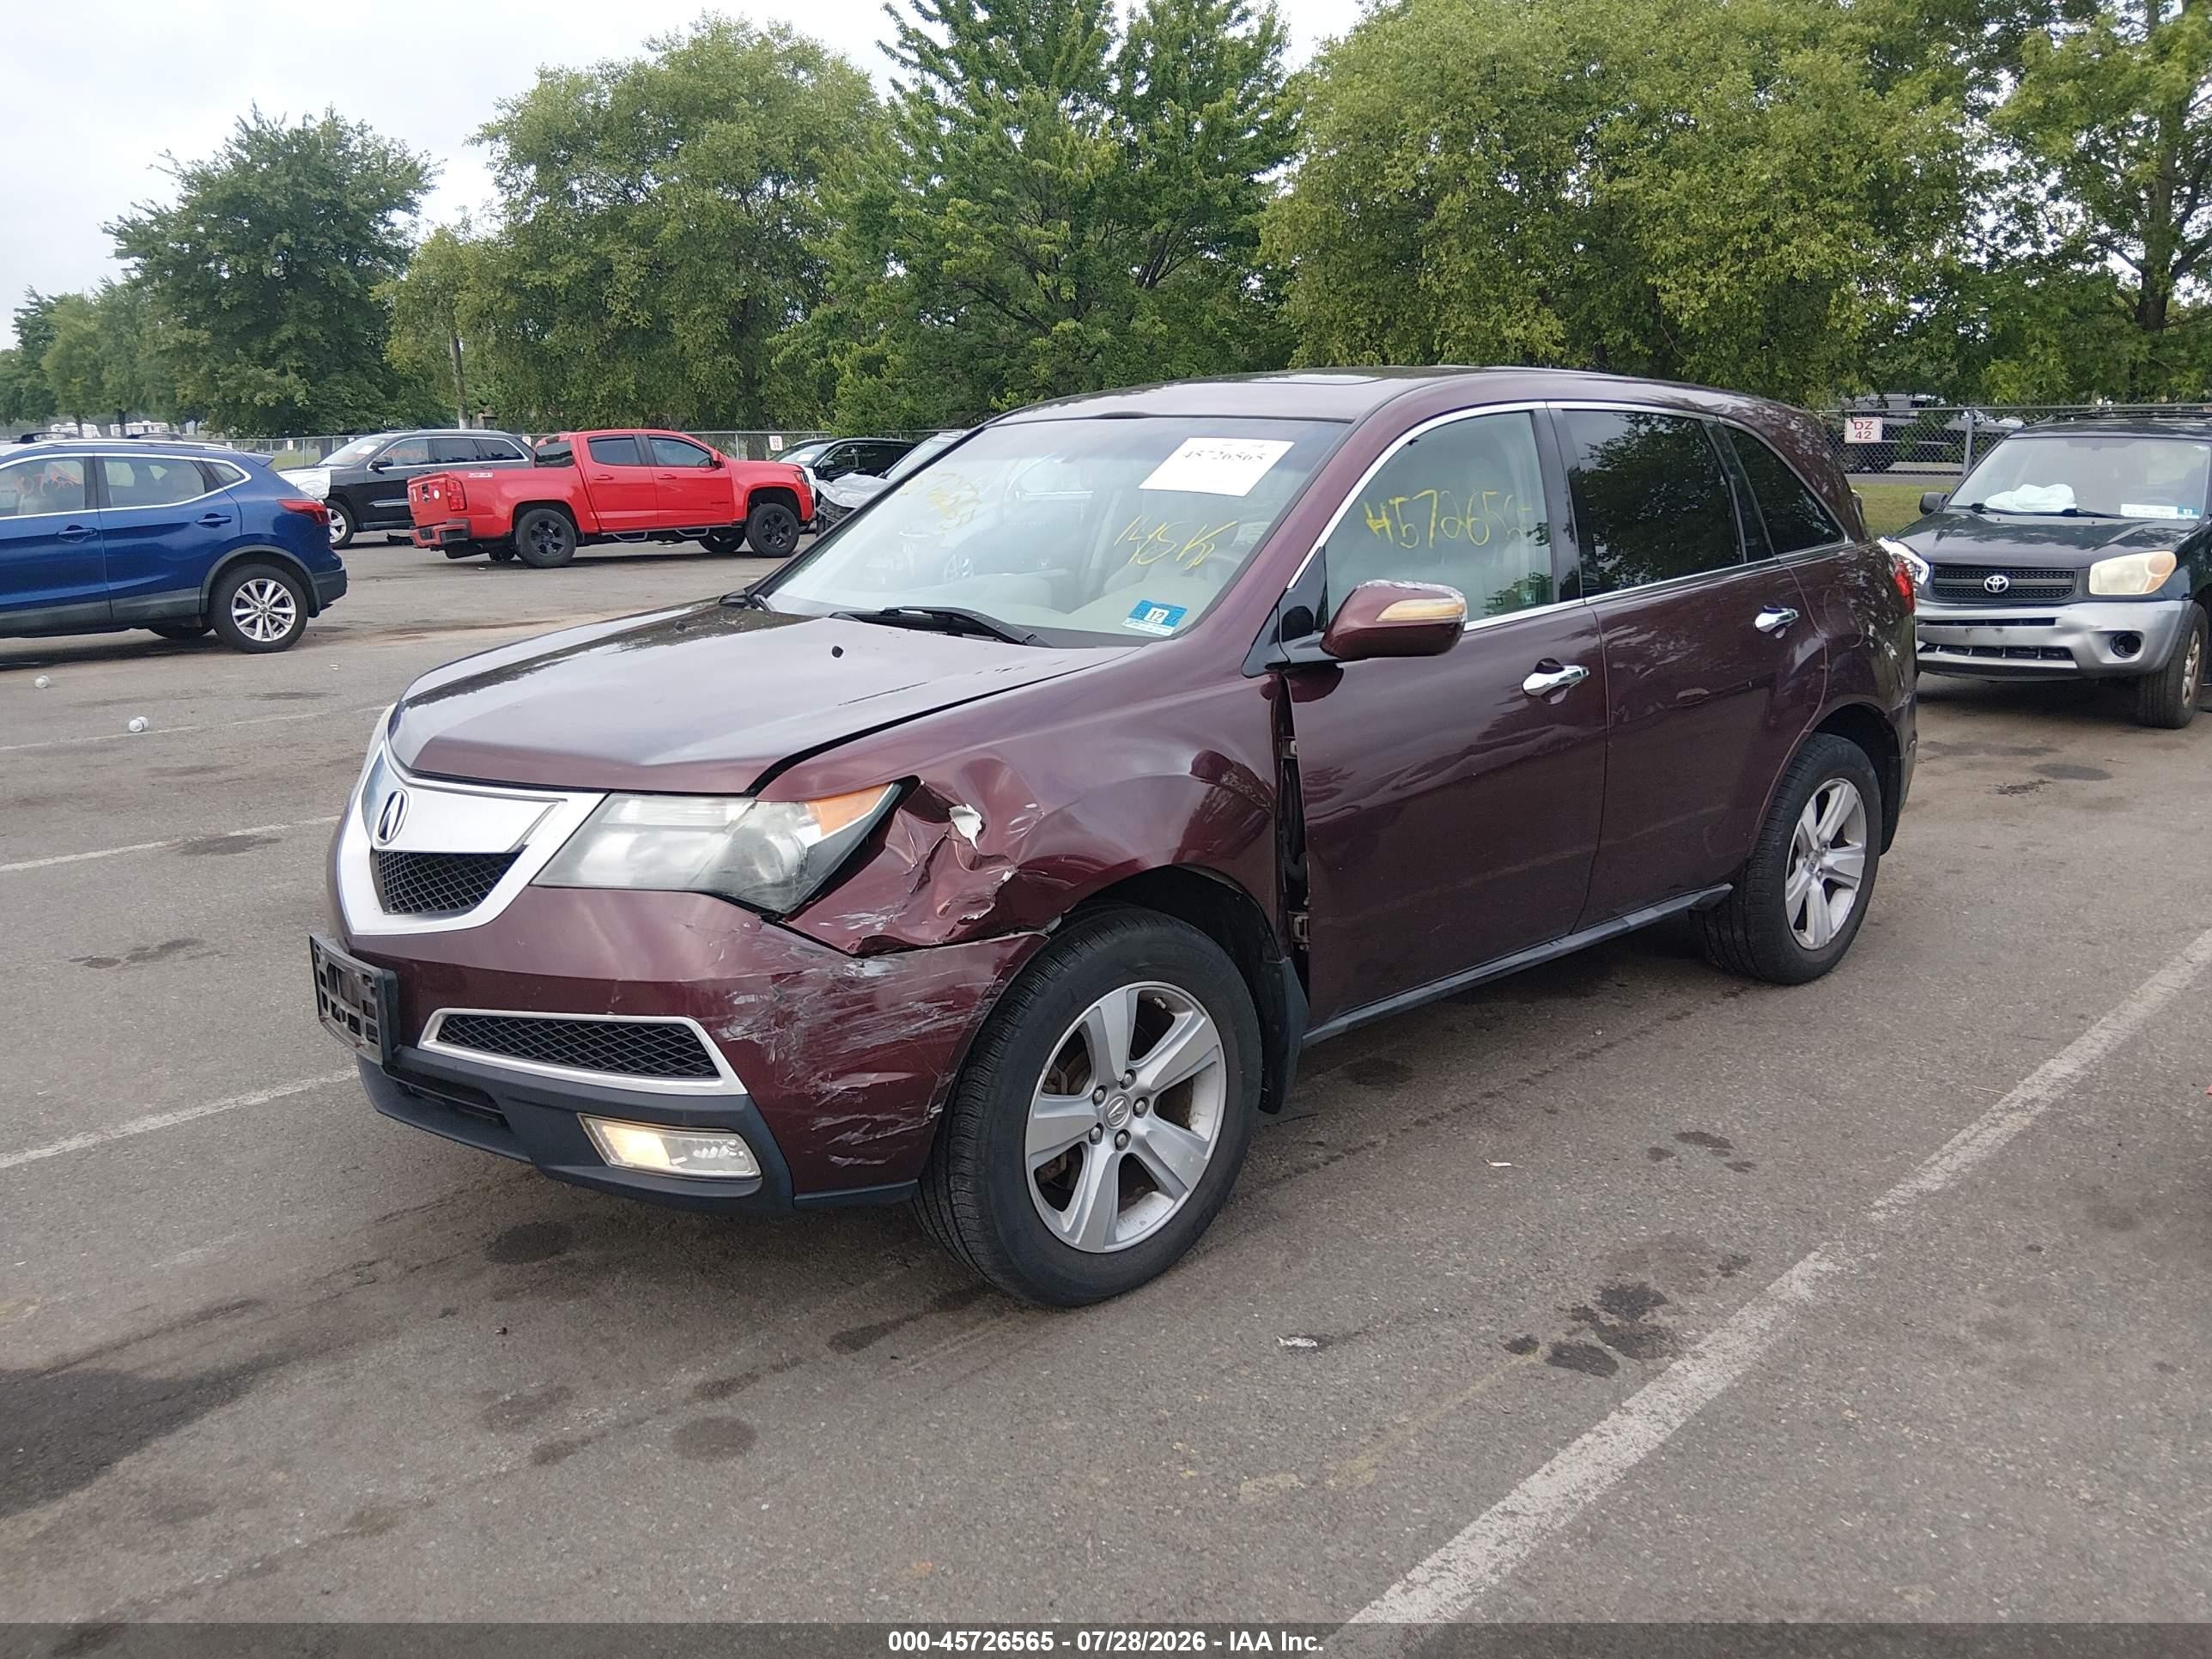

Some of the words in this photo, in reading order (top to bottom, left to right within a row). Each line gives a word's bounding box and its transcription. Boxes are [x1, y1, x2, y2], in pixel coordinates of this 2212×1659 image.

[1854, 421, 1874, 430] DZ
[1854, 431, 1872, 440] 42
[1148, 611, 1165, 622] 12
